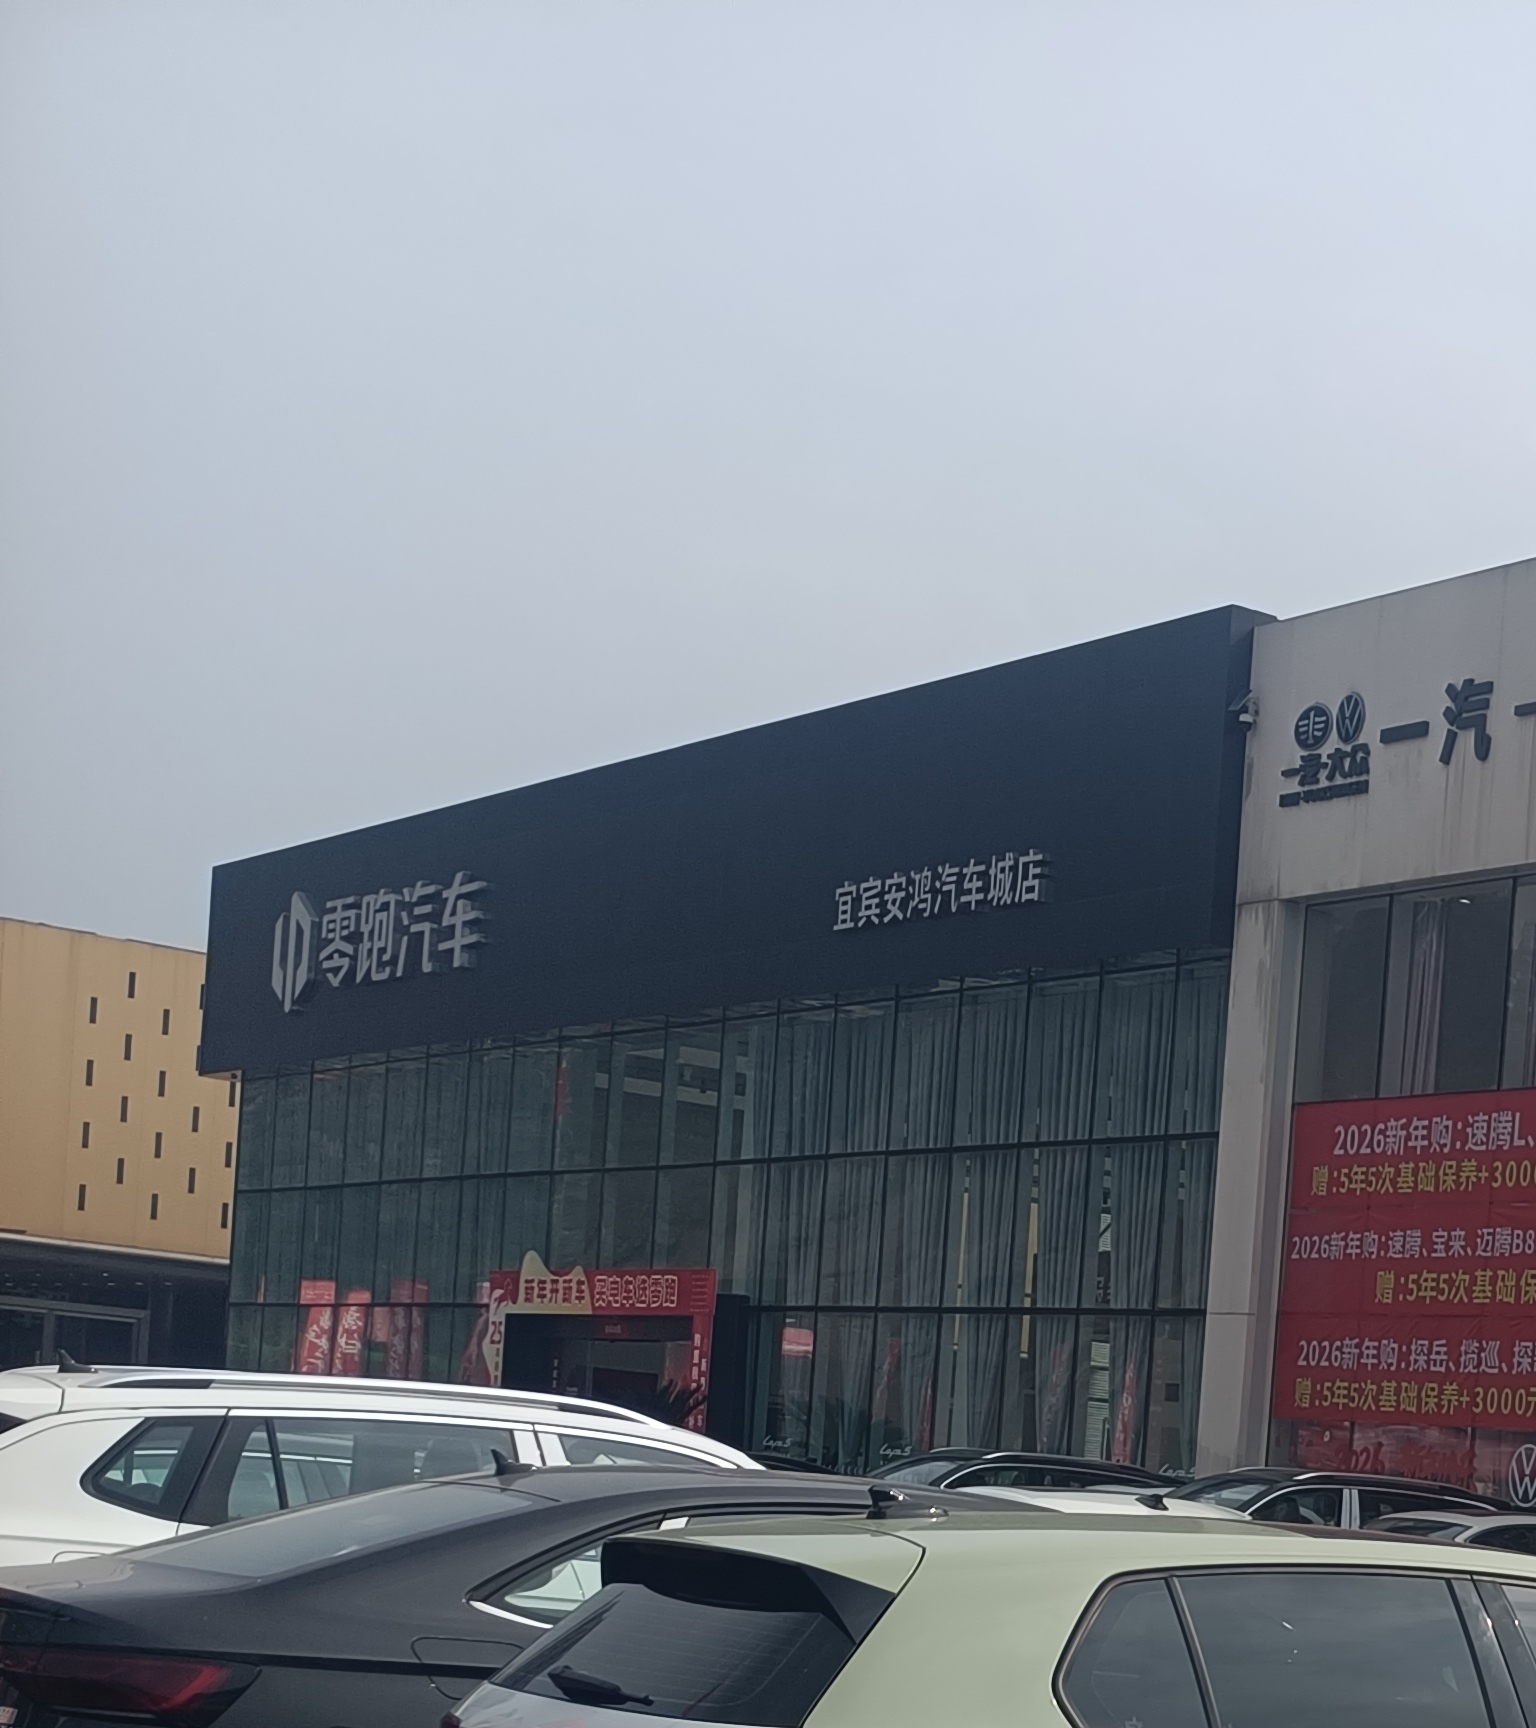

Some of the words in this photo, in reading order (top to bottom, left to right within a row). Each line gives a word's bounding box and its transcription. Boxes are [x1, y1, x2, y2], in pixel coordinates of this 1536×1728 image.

[318, 871, 490, 988] 零跑汽车
[833, 848, 1047, 931] 宜宾安鸿汽车城店
